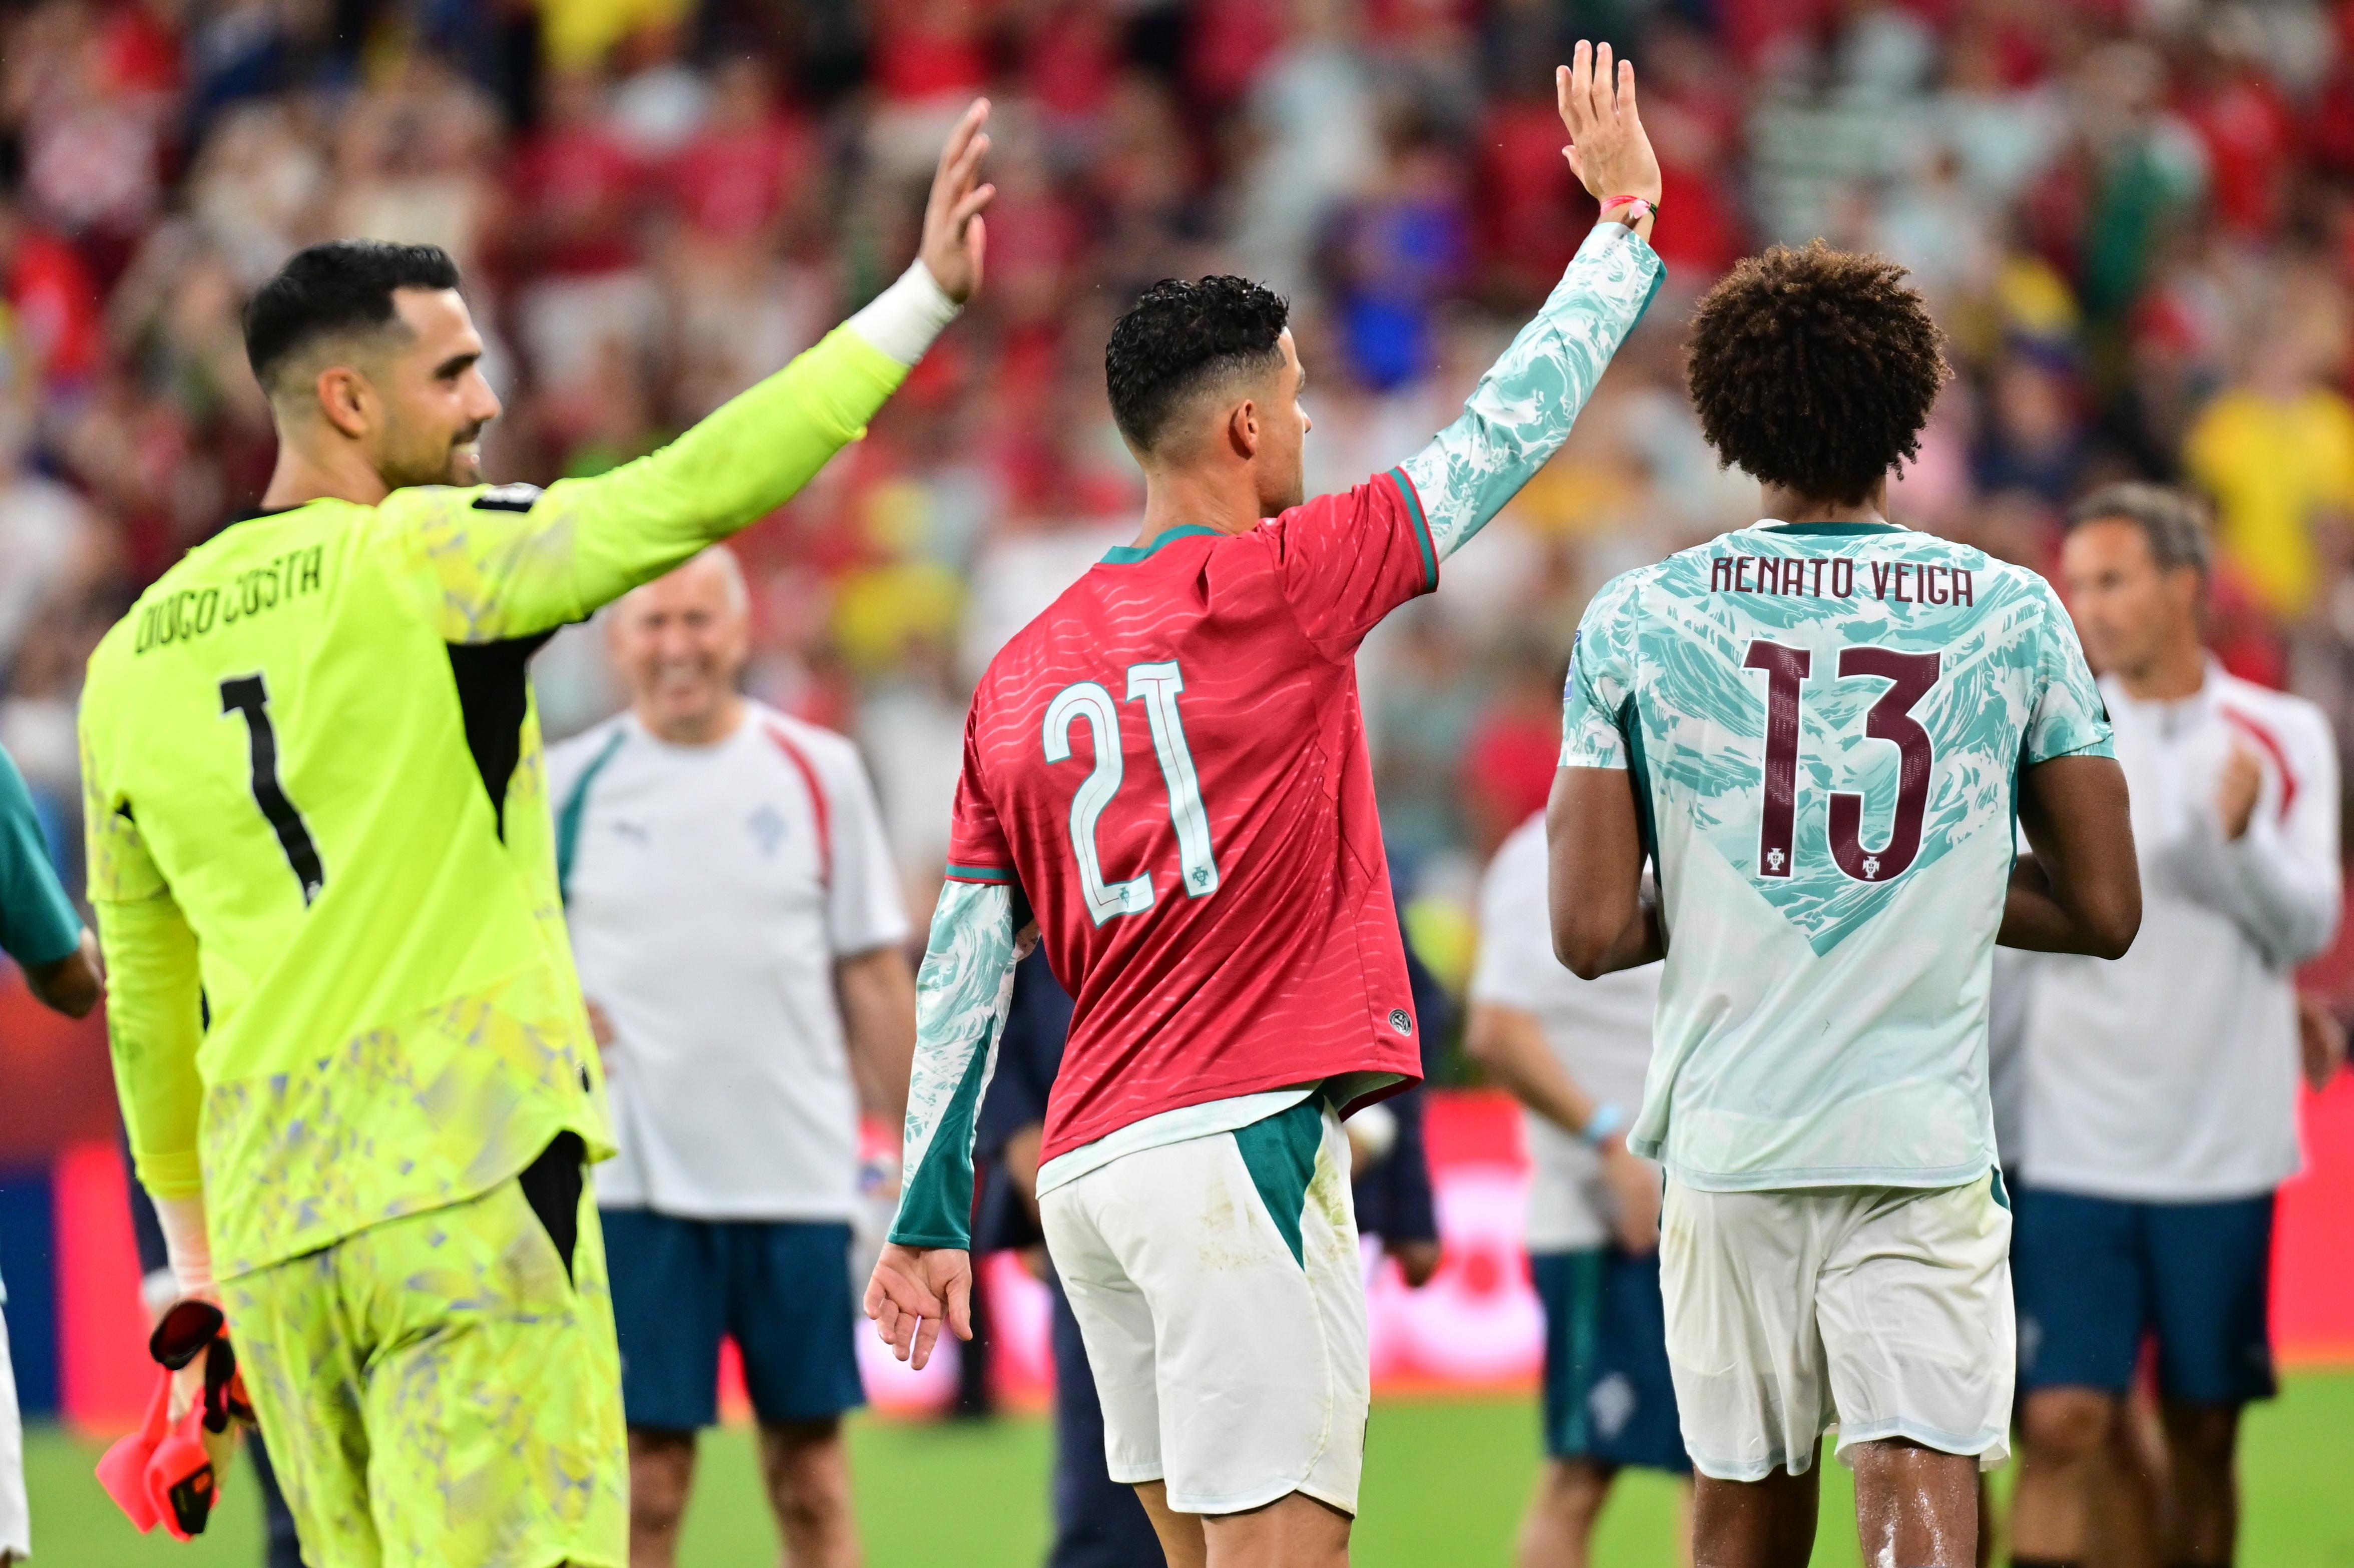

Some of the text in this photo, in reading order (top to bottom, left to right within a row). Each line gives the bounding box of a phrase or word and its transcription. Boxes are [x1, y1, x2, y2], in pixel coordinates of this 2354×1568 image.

[136, 586, 219, 654] DIOGO
[1711, 556, 1973, 607] RENATO VEIGA
[219, 673, 324, 909] 1
[1042, 660, 1219, 928] 21
[1743, 638, 1942, 884] 13
